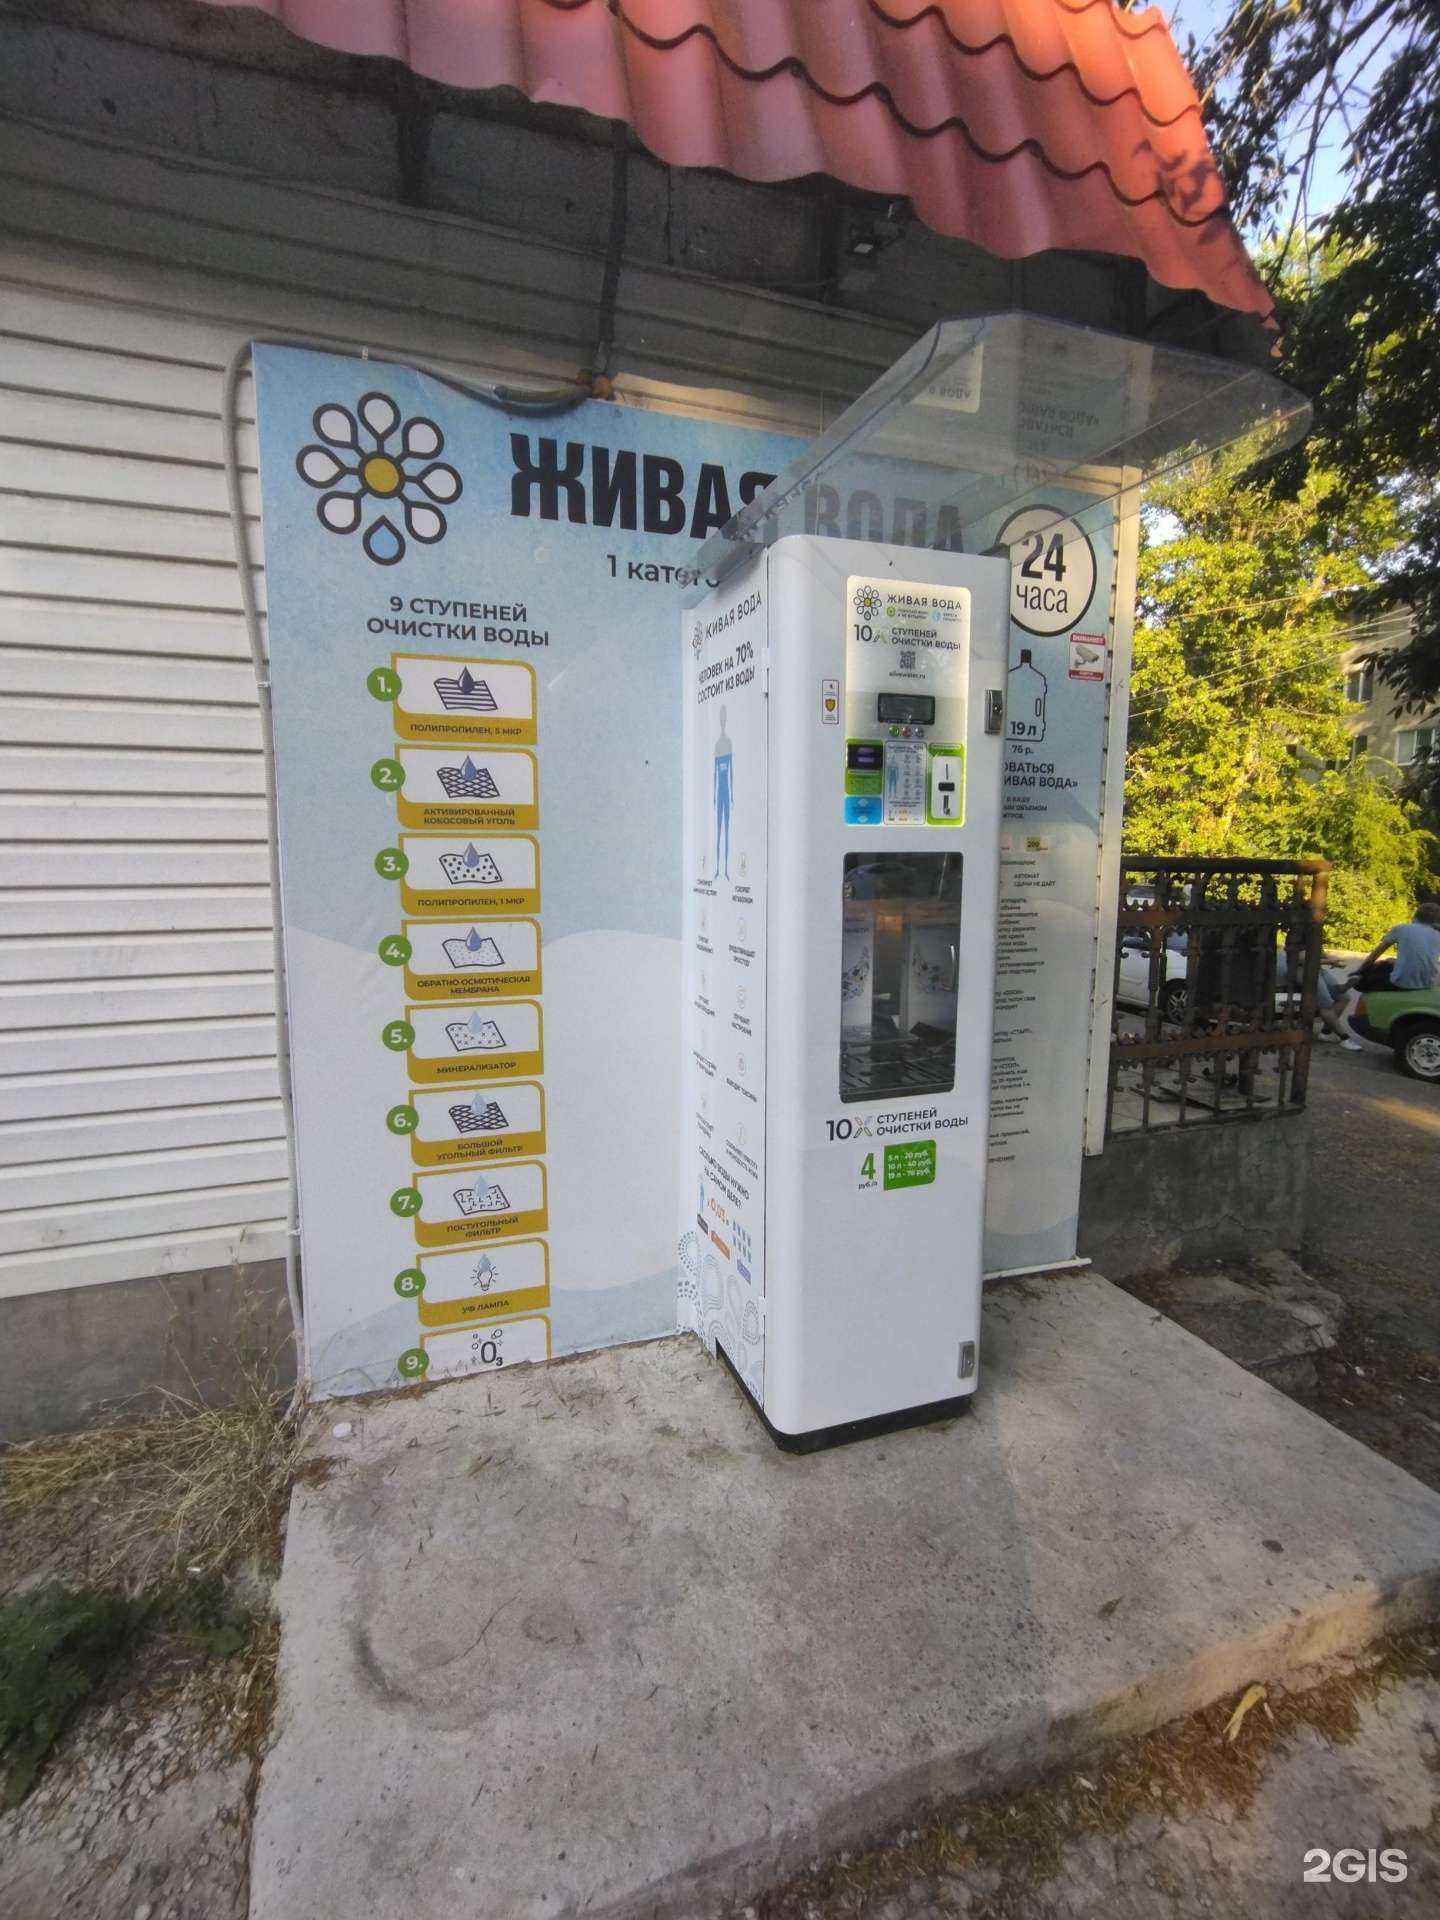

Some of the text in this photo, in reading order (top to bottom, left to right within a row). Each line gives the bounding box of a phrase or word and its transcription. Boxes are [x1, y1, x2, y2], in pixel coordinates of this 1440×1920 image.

[1021, 531, 1067, 582] 24
[606, 554, 617, 578] 1
[390, 596, 527, 623] 9 СТУПЕНЕЙ
[737, 591, 762, 620] ВОДА
[887, 594, 928, 607] ЖИВАЯ
[931, 599, 962, 611] ВОДА
[366, 617, 550, 648] ОЧИСТКИ ВОДЫ
[891, 626, 937, 639] СТУПЕНЕЙ
[891, 636, 961, 651] ОЧИСТКИ ВОДЫ
[724, 656, 734, 673] НА
[736, 641, 754, 666] 70%
[377, 676, 392, 693] 1.
[697, 666, 755, 704] СОСТОИТ ИЗ ВОДЫ
[1010, 721, 1037, 736] 19 л
[379, 767, 398, 784] 2.
[424, 817, 516, 826] КОКОСОВЫЙ УГОЛЬ
[383, 856, 402, 872] 3.
[385, 943, 406, 959] 4.
[390, 1029, 408, 1044] 5.
[436, 1062, 517, 1074] МИНЕРАЛИЗАТОР
[393, 1112, 412, 1128] 6.
[876, 1107, 938, 1124] СТУПЕНЕЙ
[876, 1116, 969, 1136] ОЧИСТКИ ВОДЫ
[860, 1152, 876, 1180] 4
[397, 1195, 417, 1211] 7.
[401, 1276, 420, 1292] 8.
[477, 1299, 510, 1312] ЛАМПА
[405, 1355, 423, 1371] 9.
